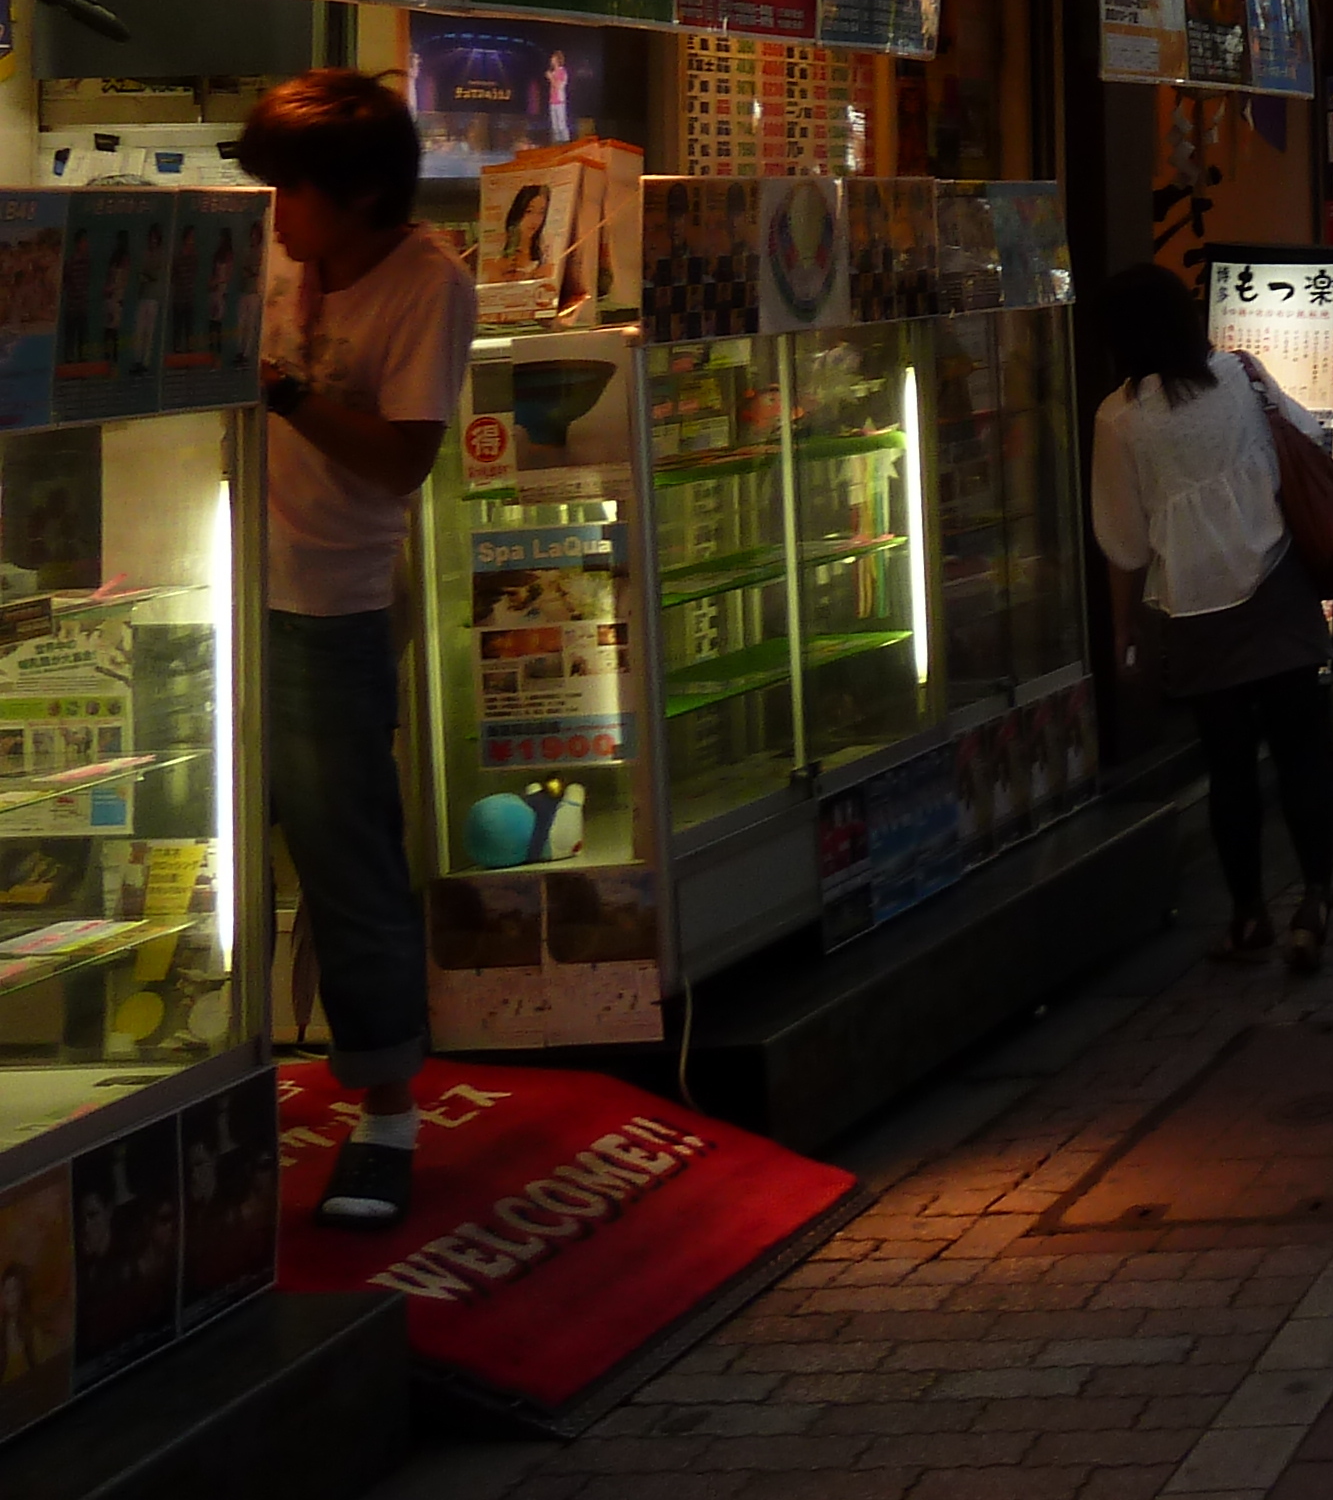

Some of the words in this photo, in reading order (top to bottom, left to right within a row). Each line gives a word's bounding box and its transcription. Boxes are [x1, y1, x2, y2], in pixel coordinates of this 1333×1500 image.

[470, 422, 502, 461] 得
[478, 540, 524, 566] Spa
[533, 534, 613, 560] LaQua
[488, 732, 617, 763] ¥1900
[366, 1116, 705, 1300] WELCOME!!
